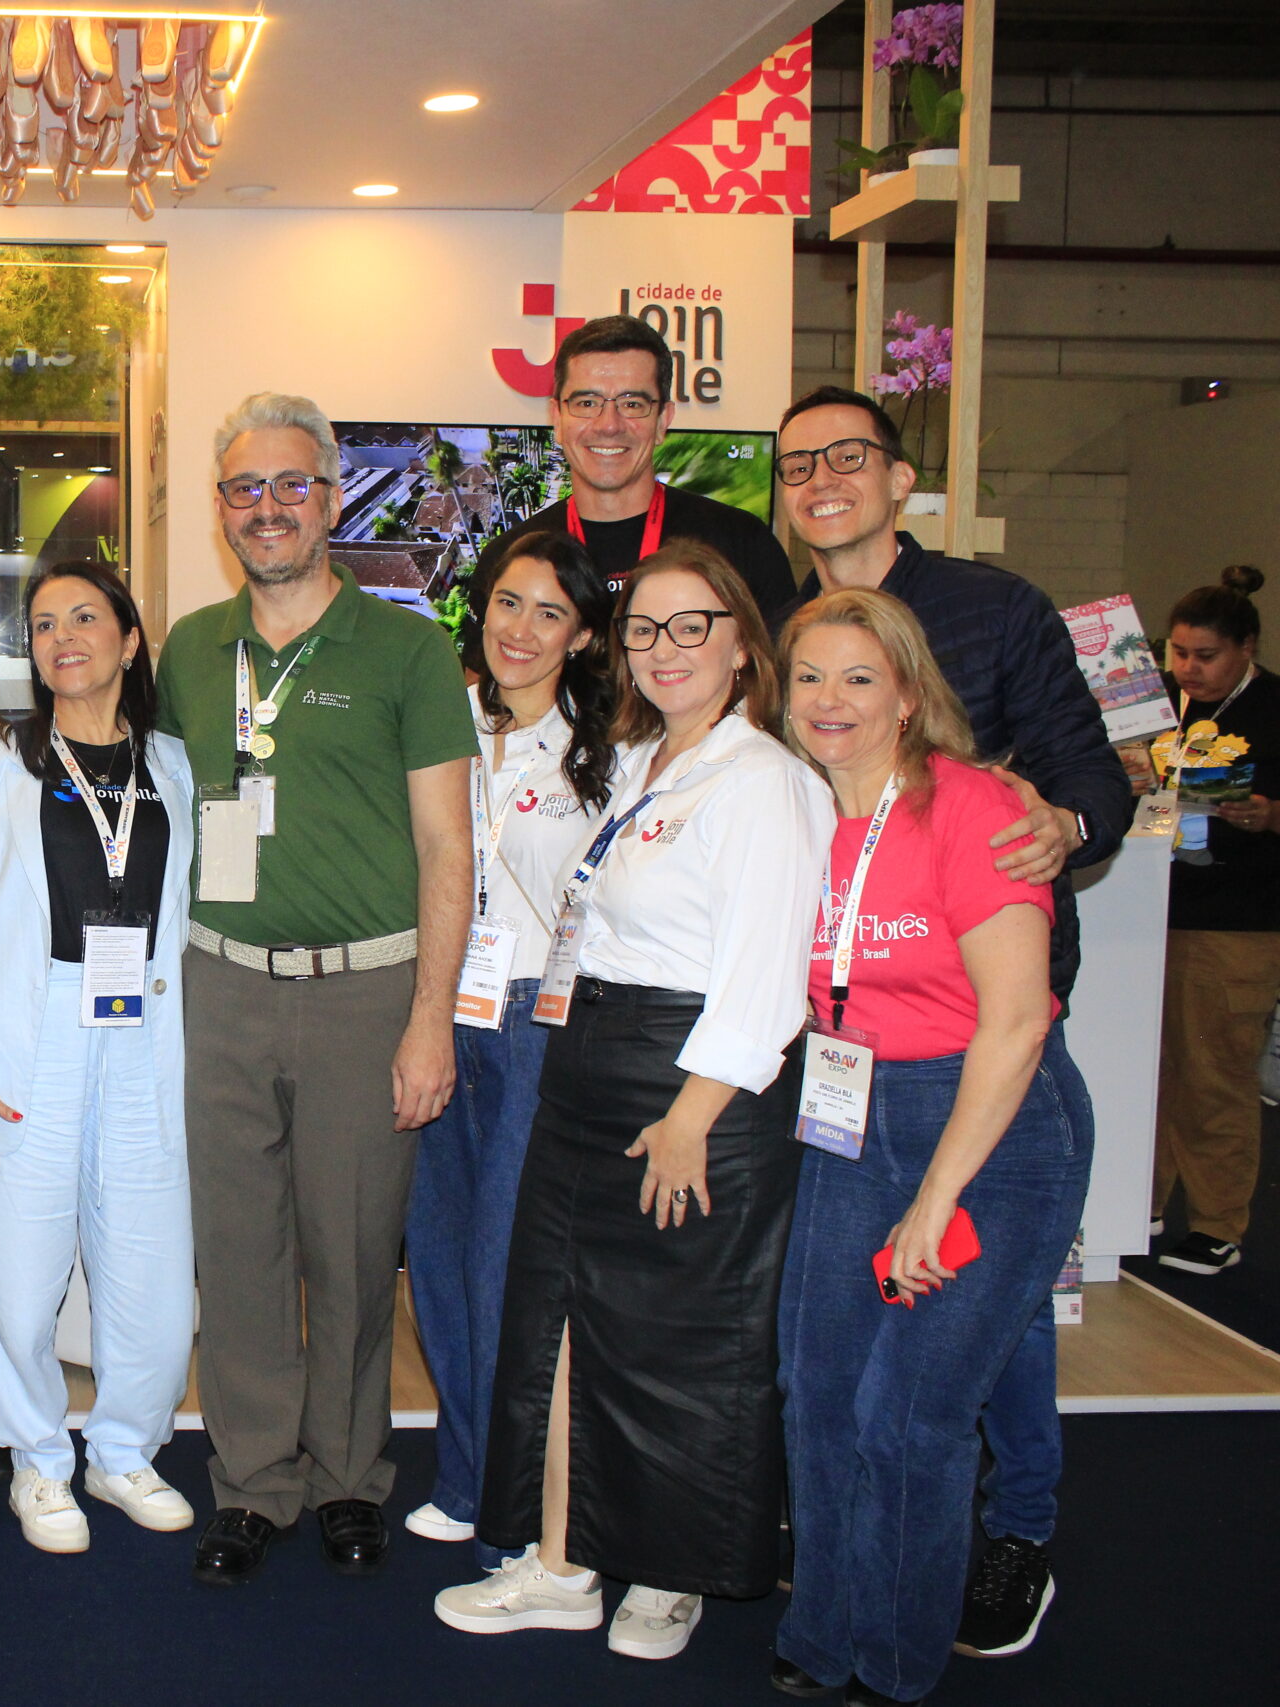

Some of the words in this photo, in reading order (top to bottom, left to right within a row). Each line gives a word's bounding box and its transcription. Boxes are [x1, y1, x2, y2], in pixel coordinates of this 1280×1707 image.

[637, 283, 695, 300] cidade
[701, 284, 723, 301] de
[317, 700, 350, 709] JOINVILLE
[319, 692, 351, 701] INSTITUTO
[237, 707, 249, 739] ABAV
[65, 758, 78, 775] GOL
[102, 836, 121, 869] ABAV
[864, 818, 883, 855] ABAV
[878, 799, 890, 817] EXPO
[857, 913, 929, 942] Flores
[469, 930, 500, 946] BAV
[837, 946, 850, 971] GOL
[863, 948, 891, 959] Brasil
[456, 1000, 482, 1011] positor
[820, 1048, 858, 1069] ABAV
[828, 1063, 848, 1075] EXPO
[815, 1123, 846, 1143] MÍDIA
